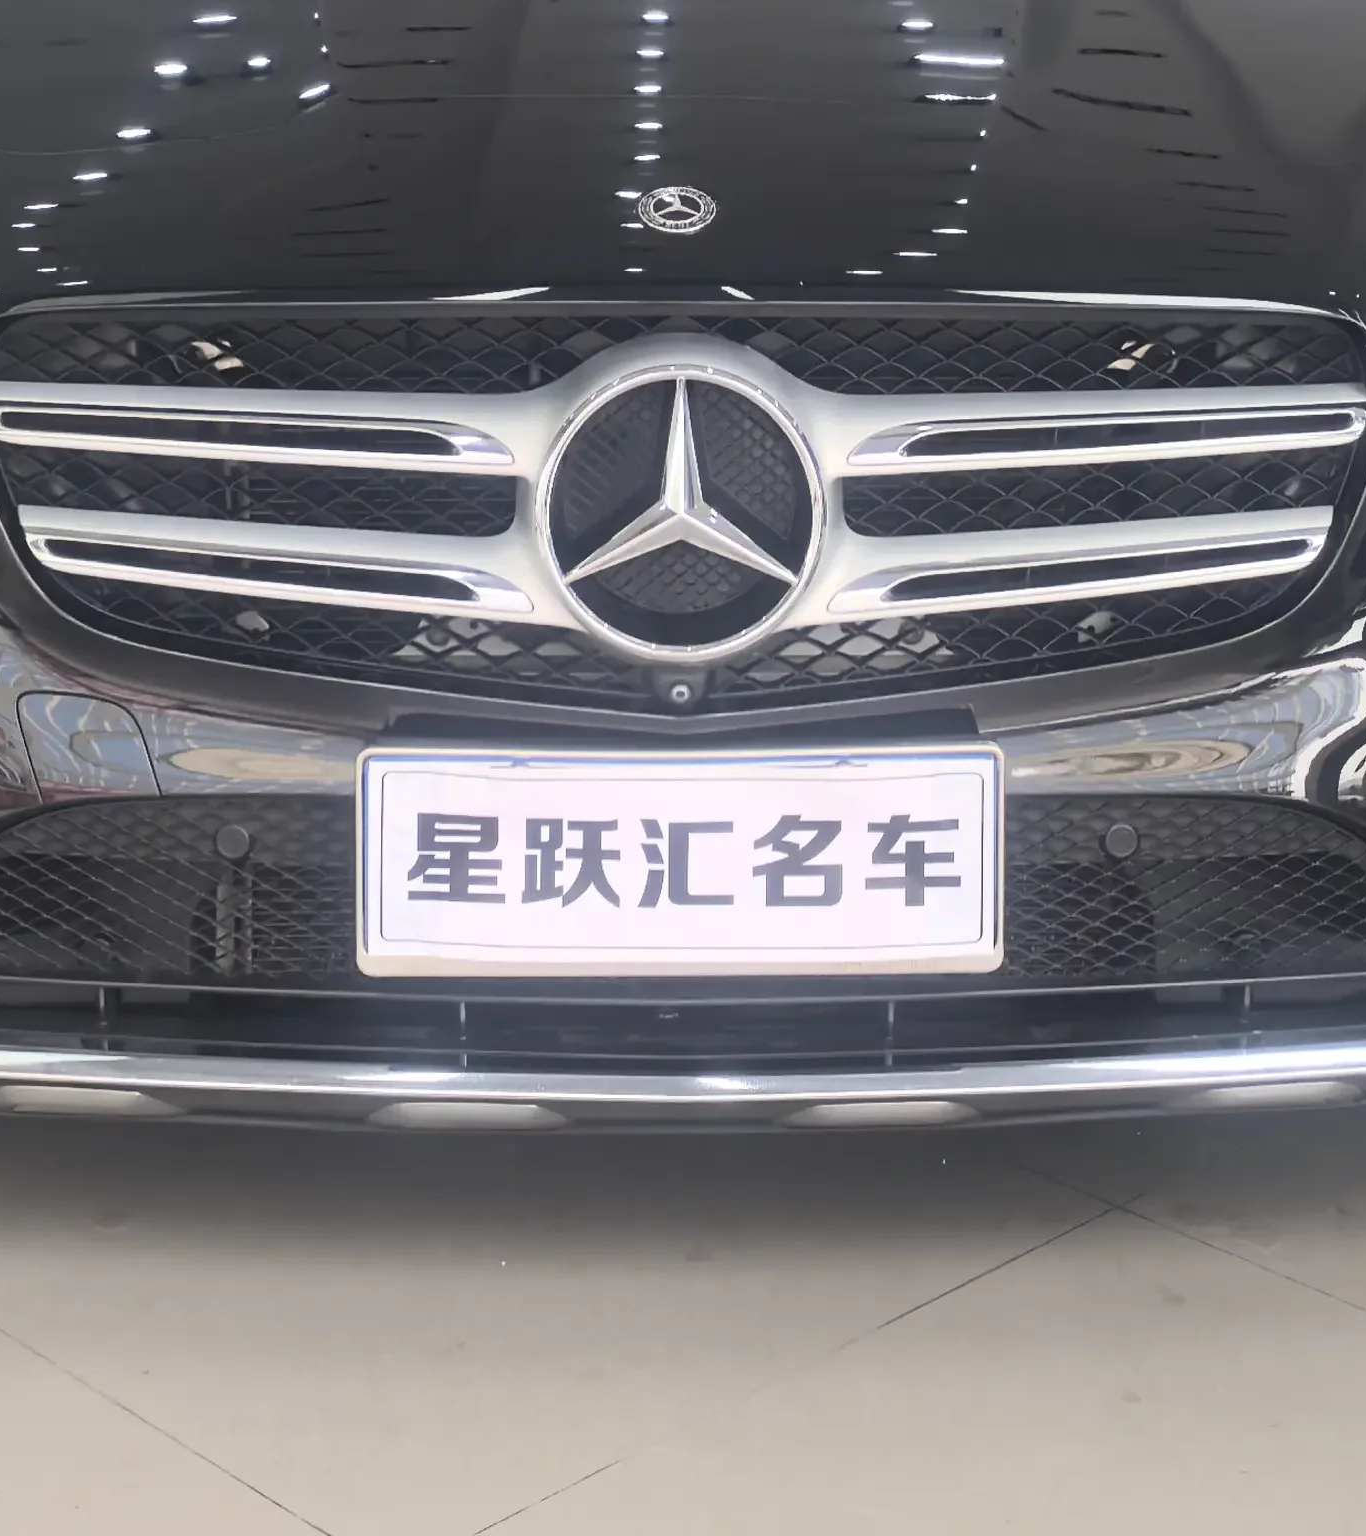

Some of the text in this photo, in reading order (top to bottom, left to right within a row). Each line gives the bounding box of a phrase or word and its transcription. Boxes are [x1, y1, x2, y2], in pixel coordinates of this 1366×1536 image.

[407, 812, 962, 909] 星跃汇名车
